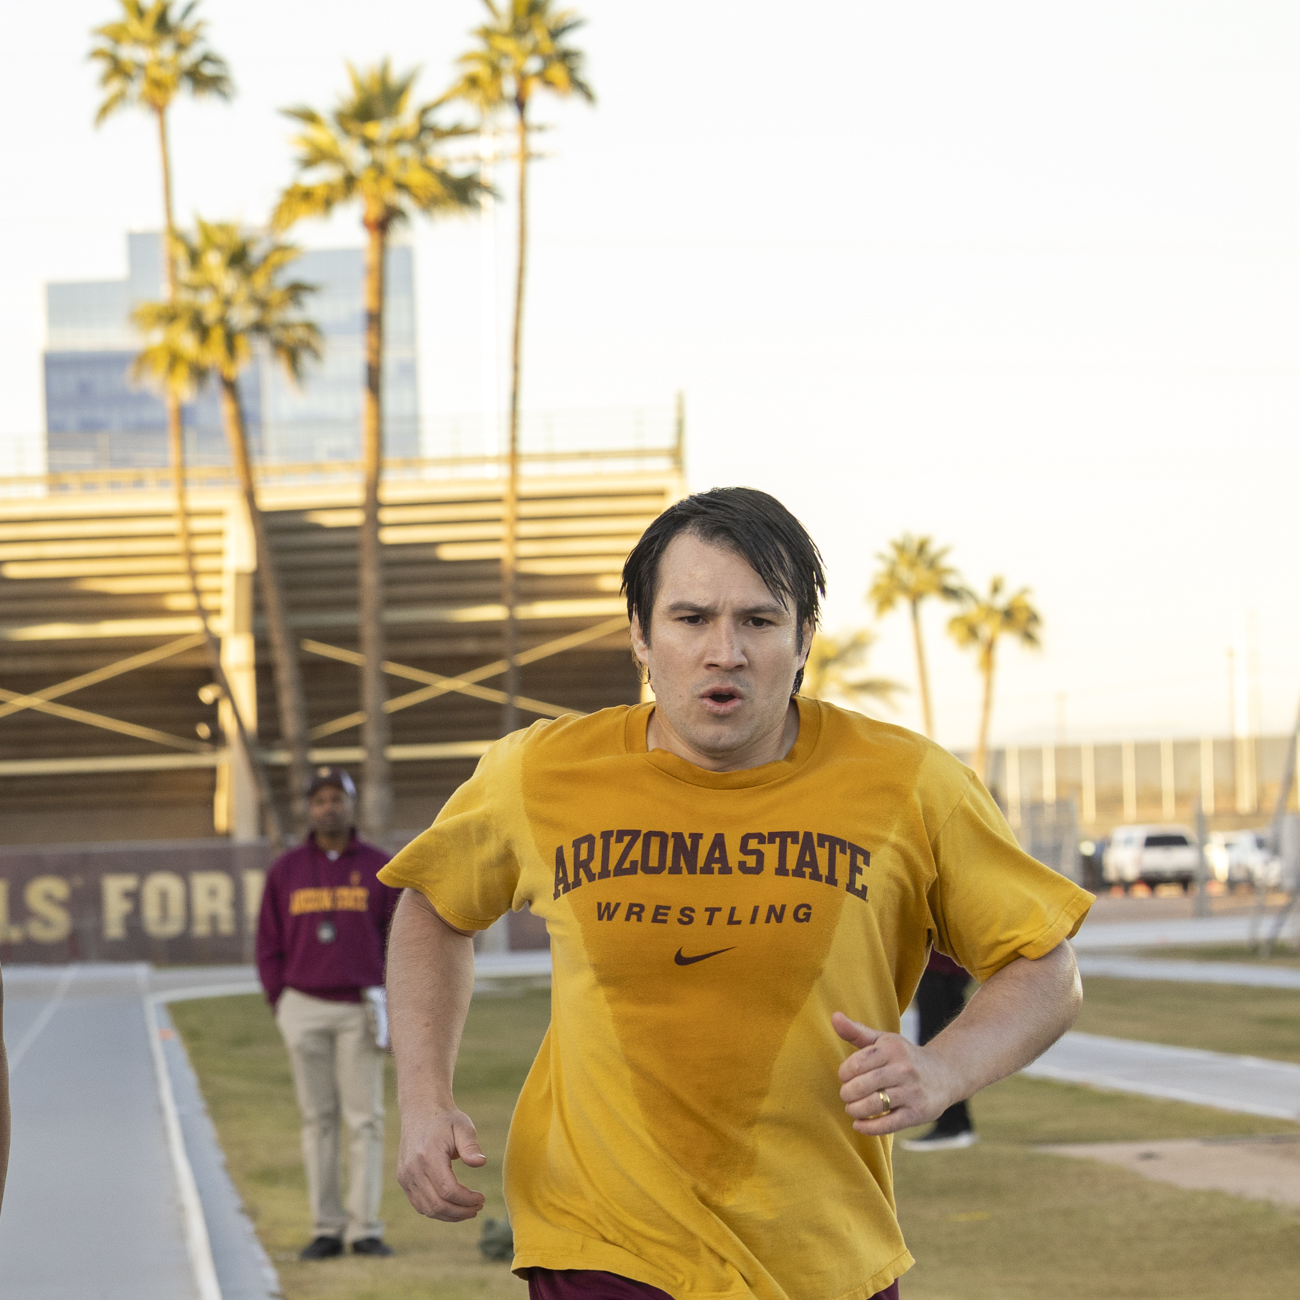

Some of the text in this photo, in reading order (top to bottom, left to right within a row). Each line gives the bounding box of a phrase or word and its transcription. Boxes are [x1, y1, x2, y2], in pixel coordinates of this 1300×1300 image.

[553, 829, 870, 902] ARIZONA STATE
[596, 901, 813, 926] WRESTLING
